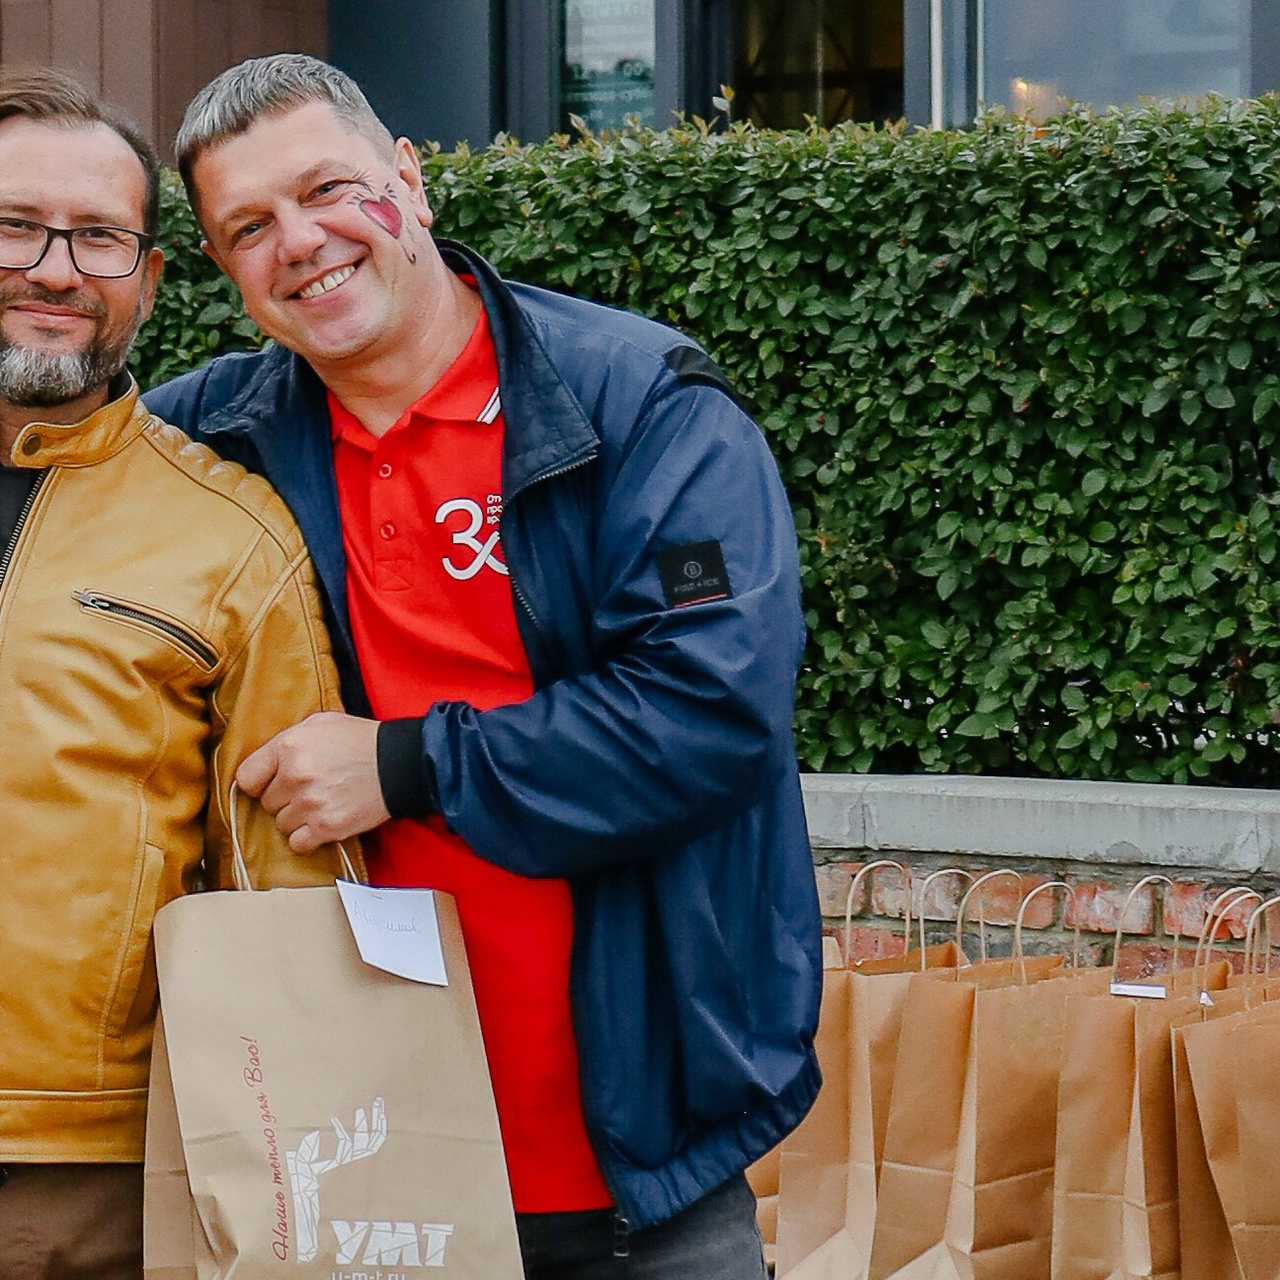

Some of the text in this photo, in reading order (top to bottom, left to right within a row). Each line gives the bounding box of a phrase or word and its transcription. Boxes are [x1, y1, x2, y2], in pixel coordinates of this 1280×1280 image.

[257, 1091, 277, 1123] для
[263, 1127, 283, 1186] тепло
[271, 1190, 289, 1261] Наше
[330, 1220, 454, 1267] УМТ
